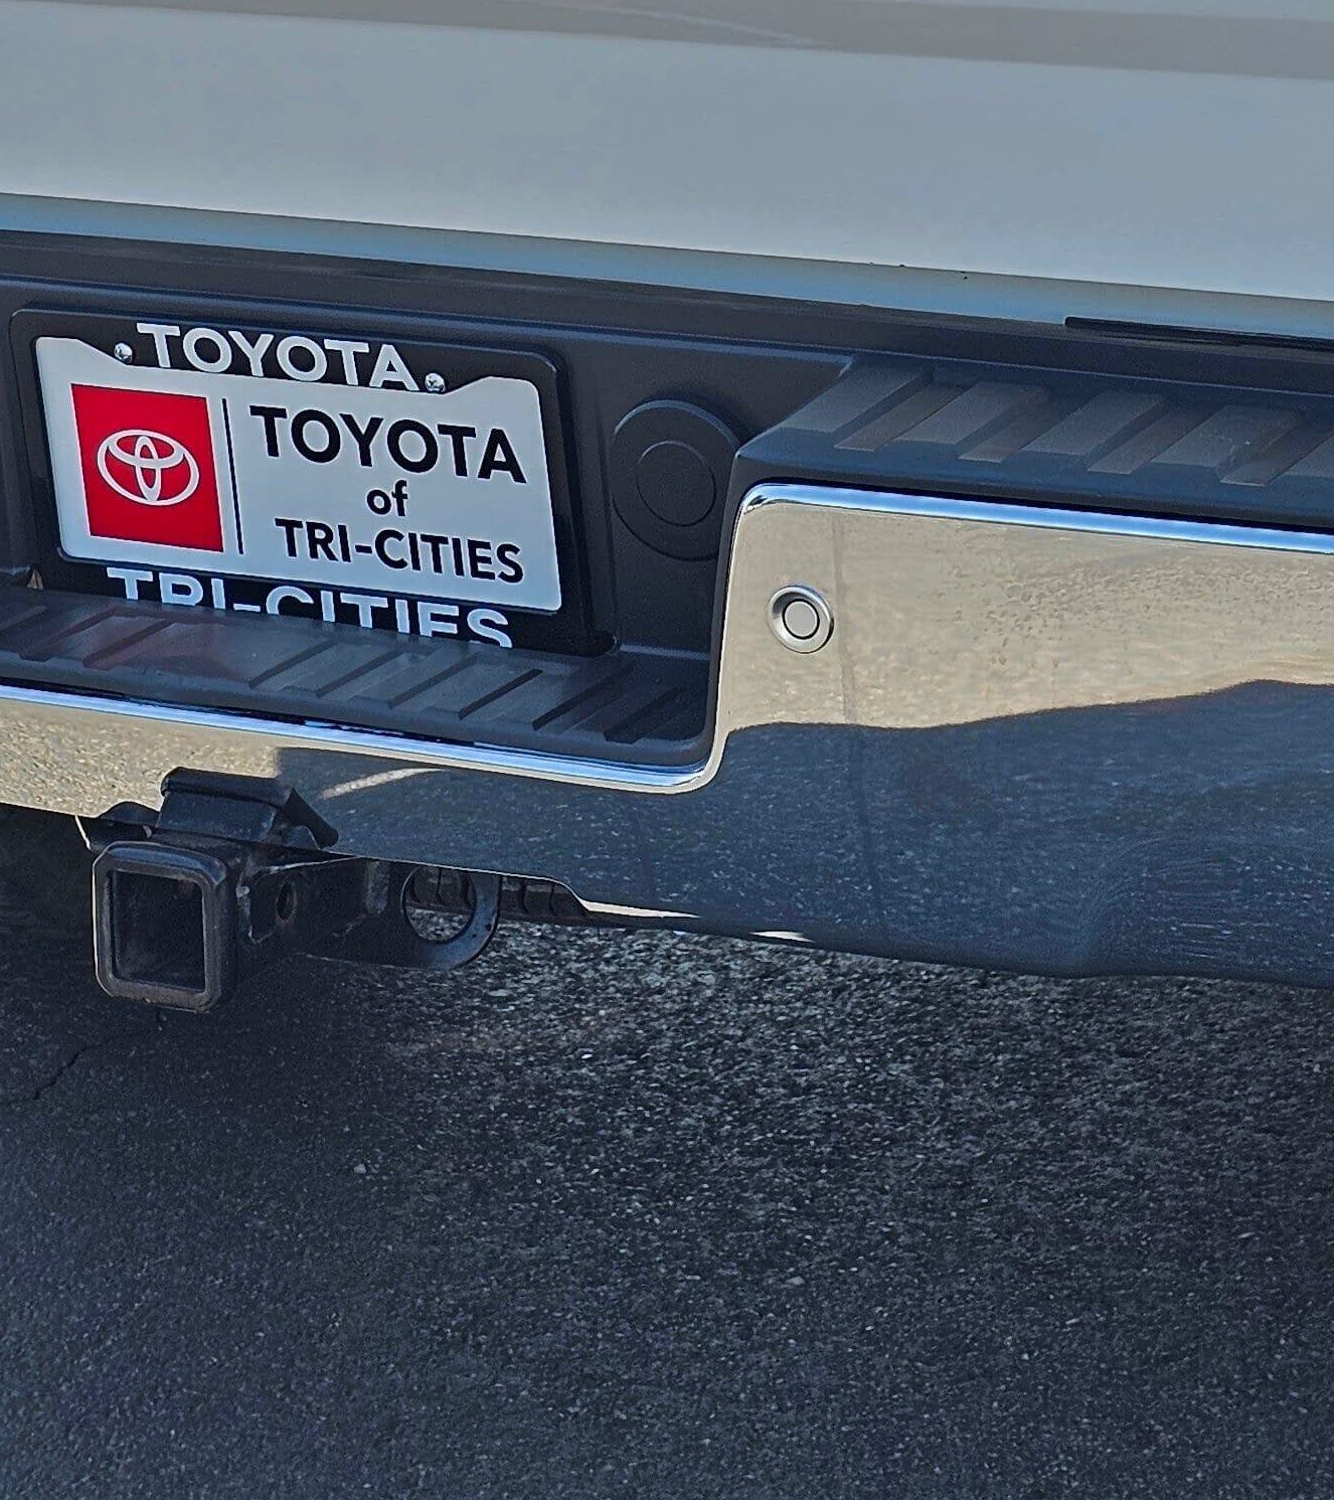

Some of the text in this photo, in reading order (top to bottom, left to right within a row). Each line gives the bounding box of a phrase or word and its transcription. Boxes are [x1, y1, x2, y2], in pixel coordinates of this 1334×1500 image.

[136, 322, 419, 392] TOYOTA
[250, 405, 526, 484] TOYOTA
[366, 480, 409, 517] of
[275, 518, 524, 584] TRI-CITIES
